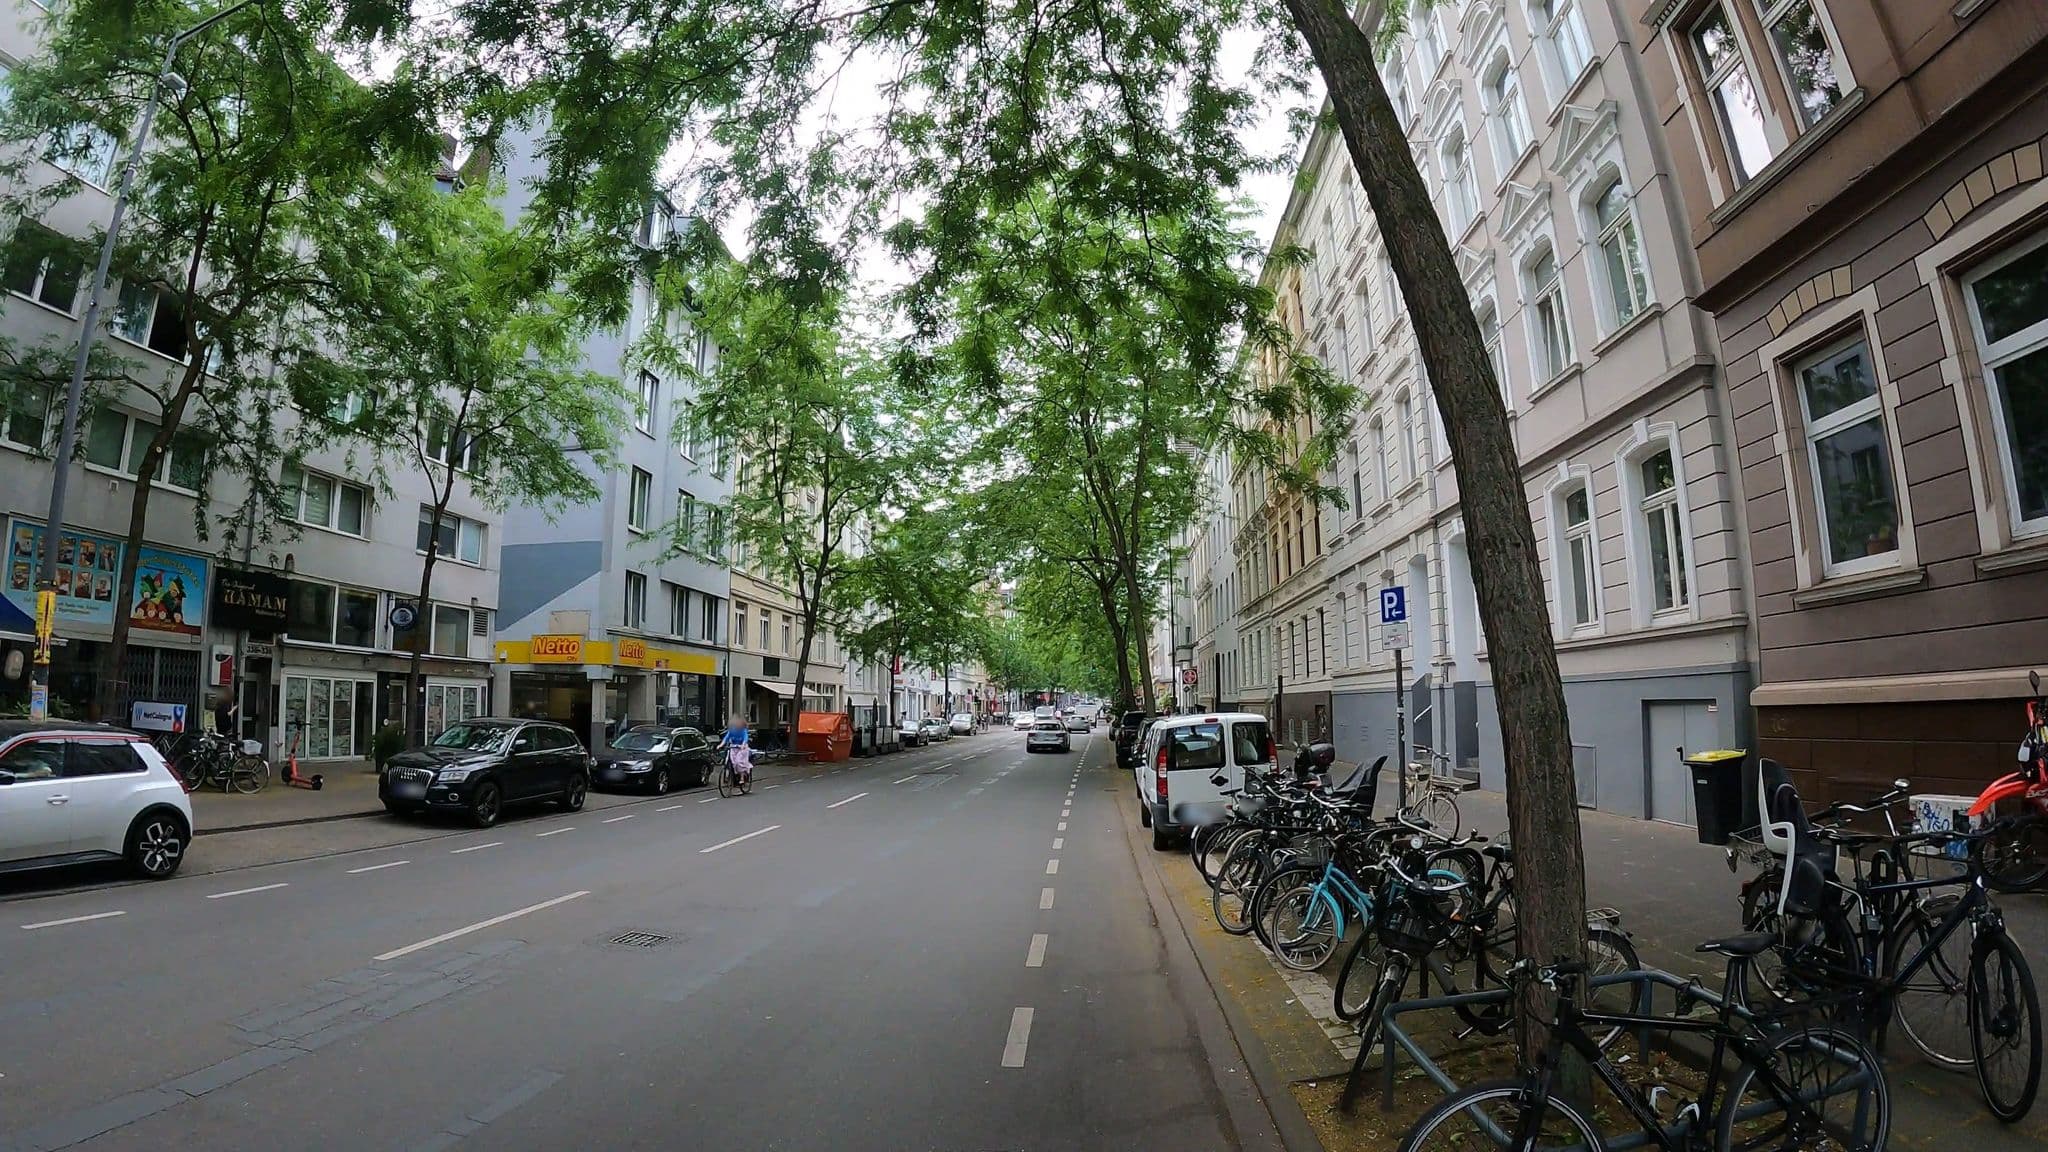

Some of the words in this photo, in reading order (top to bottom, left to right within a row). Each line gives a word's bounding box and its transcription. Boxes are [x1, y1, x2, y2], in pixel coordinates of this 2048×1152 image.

[1384, 592, 1398, 618] P
[533, 636, 580, 655] Netto
[619, 640, 645, 658] Netto
